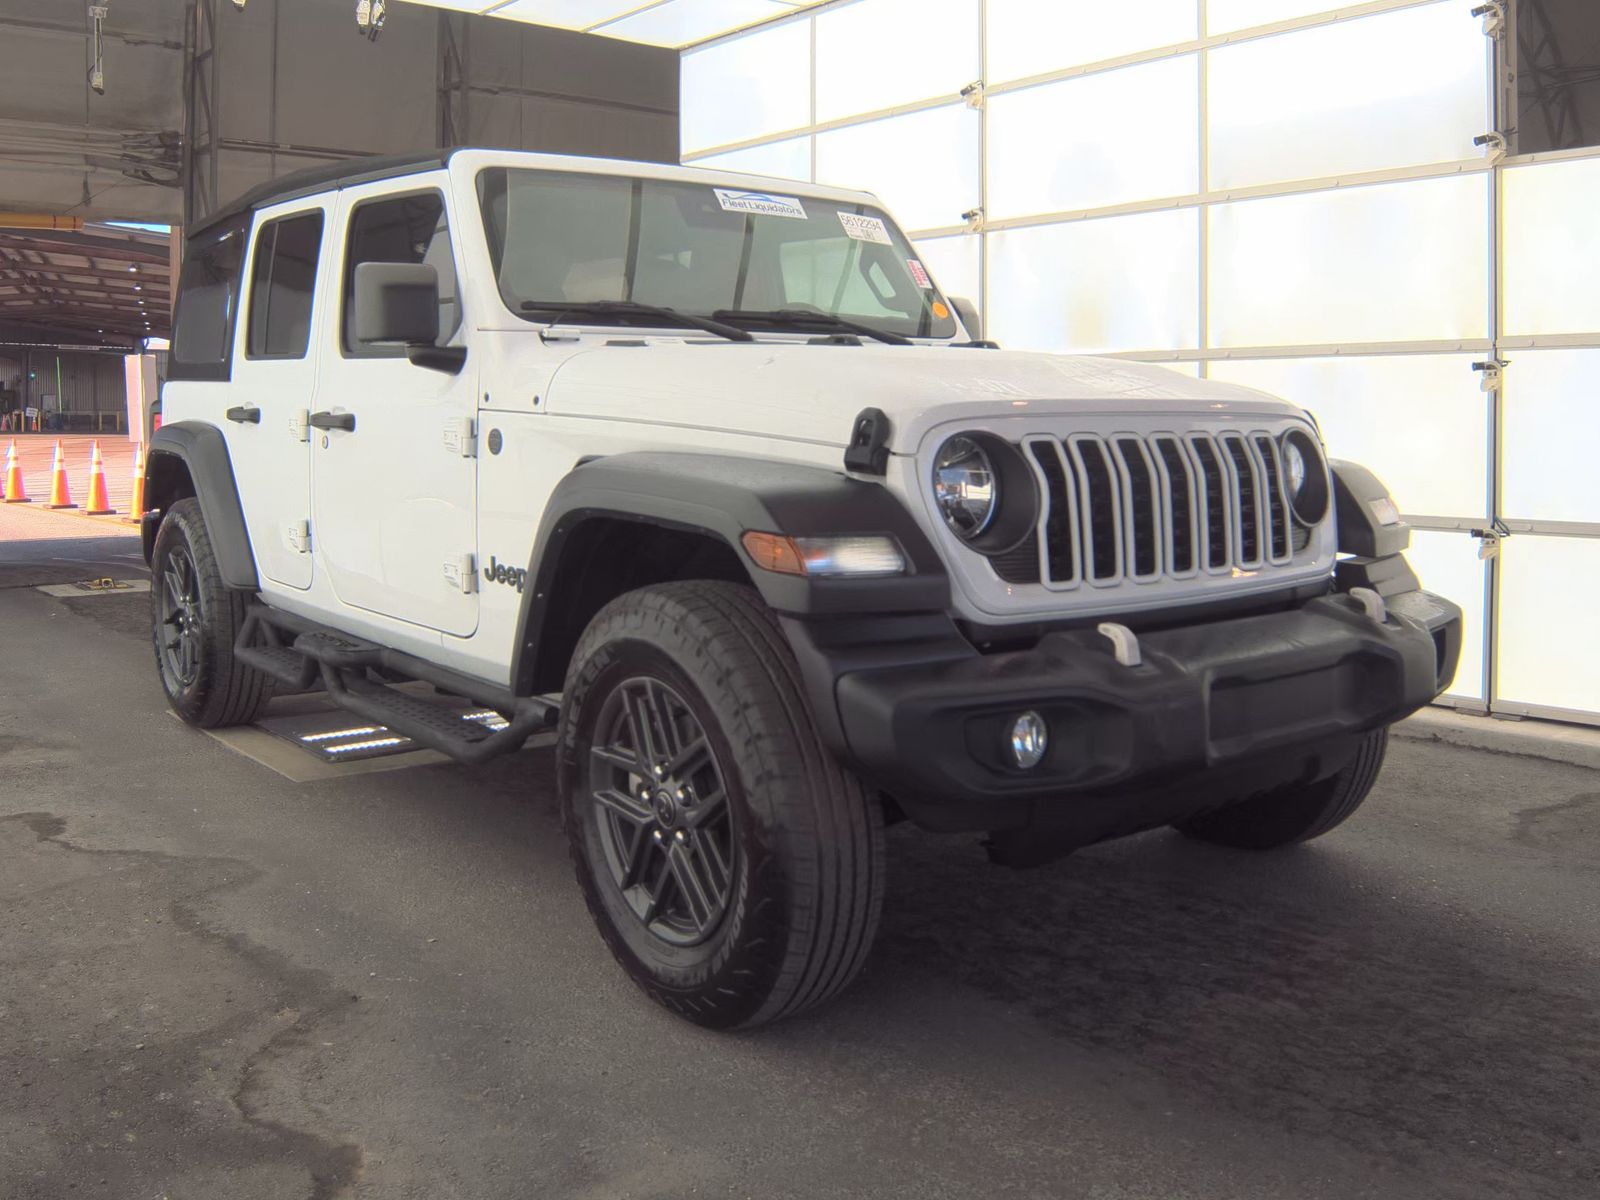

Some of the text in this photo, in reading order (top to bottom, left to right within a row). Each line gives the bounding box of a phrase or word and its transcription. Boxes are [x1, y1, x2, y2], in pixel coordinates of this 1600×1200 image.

[722, 198, 802, 215] Fleet Liquidators
[484, 555, 527, 593] Jeep
[565, 645, 610, 749] NEXEN
